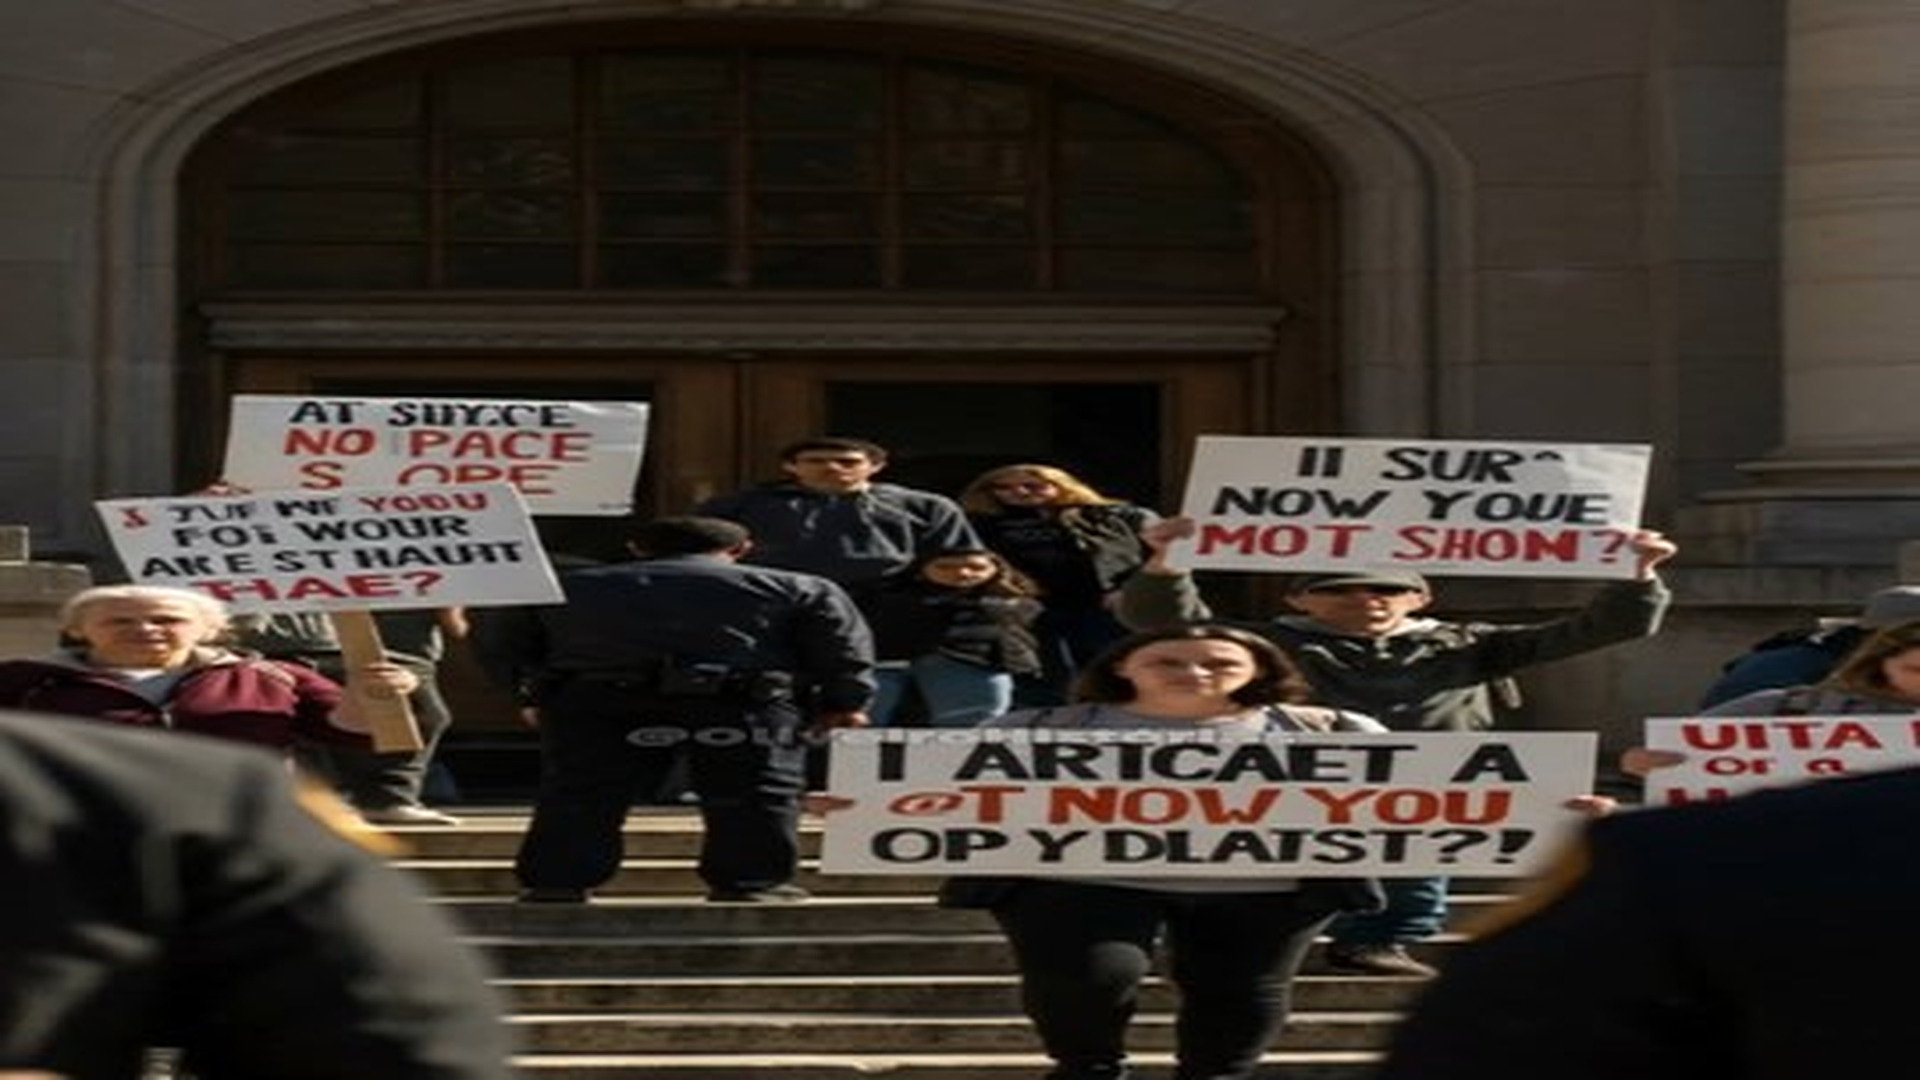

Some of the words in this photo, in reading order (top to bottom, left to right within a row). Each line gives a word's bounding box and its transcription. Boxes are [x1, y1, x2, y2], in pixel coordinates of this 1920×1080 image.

[289, 401, 364, 424] AT
[284, 428, 376, 456] NO
[409, 429, 593, 461] PACE
[1211, 486, 1393, 518] NOW
[1422, 488, 1612, 524] YOUE
[294, 514, 470, 542] WOUR
[1196, 524, 1373, 557] MOT
[879, 742, 905, 781] I
[1451, 743, 1530, 783] A
[1050, 786, 1282, 825] NOW
[1303, 788, 1512, 826] YOU
[871, 828, 1008, 862] OP
